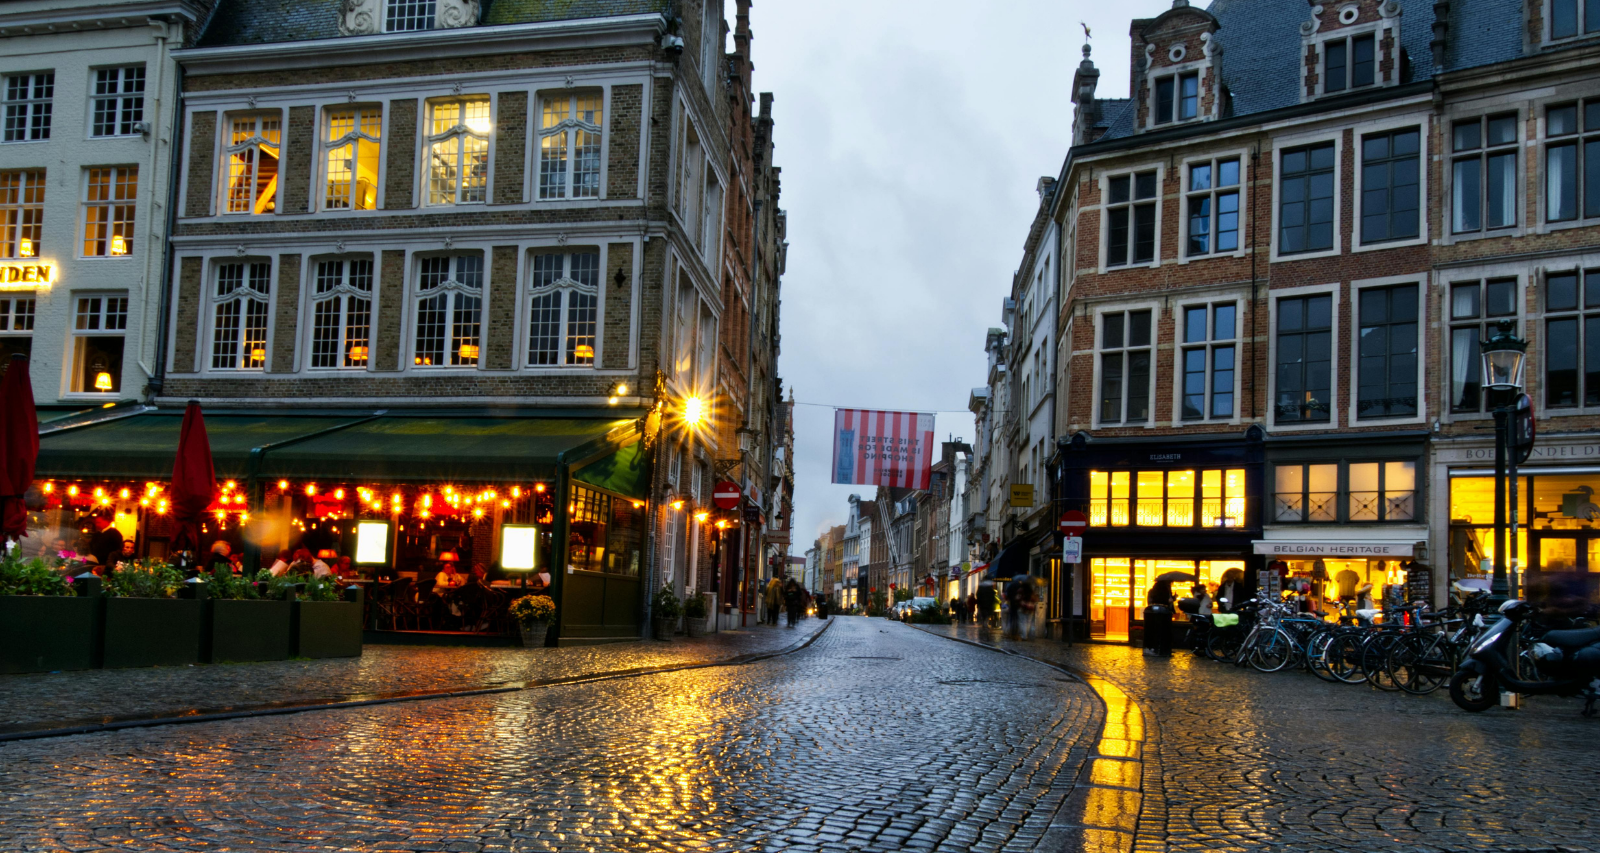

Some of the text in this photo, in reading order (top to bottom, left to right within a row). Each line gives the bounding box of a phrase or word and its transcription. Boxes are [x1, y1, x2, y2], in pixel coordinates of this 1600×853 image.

[1466, 446, 1576, 459] BOENDEL
[1274, 545, 1390, 554] BELGIAN HERITAGE
